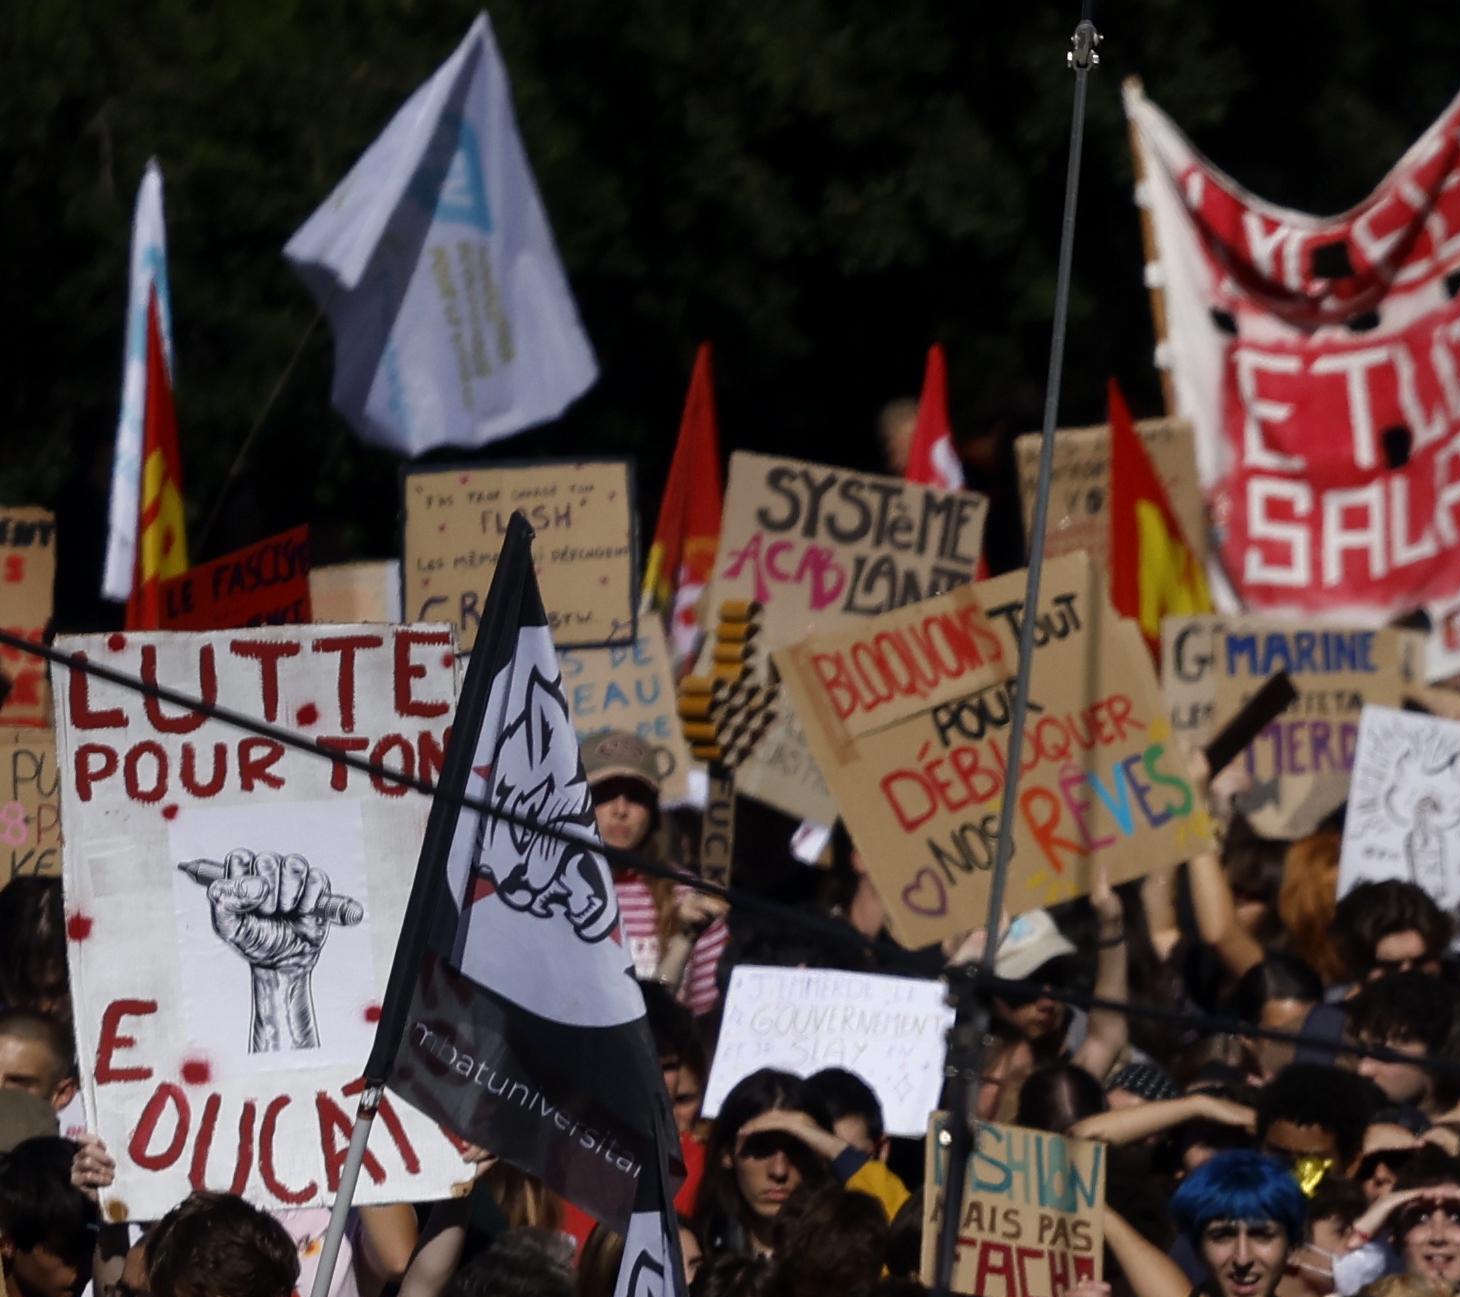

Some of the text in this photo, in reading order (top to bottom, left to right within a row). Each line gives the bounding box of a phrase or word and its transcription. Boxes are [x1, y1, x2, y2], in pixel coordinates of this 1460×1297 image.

[724, 532, 847, 609] ACAB
[811, 606, 1003, 720] BLOQUONS
[1225, 631, 1377, 676] MARINE
[75, 740, 285, 802] POUR
[1039, 1208, 1093, 1252] PAS
